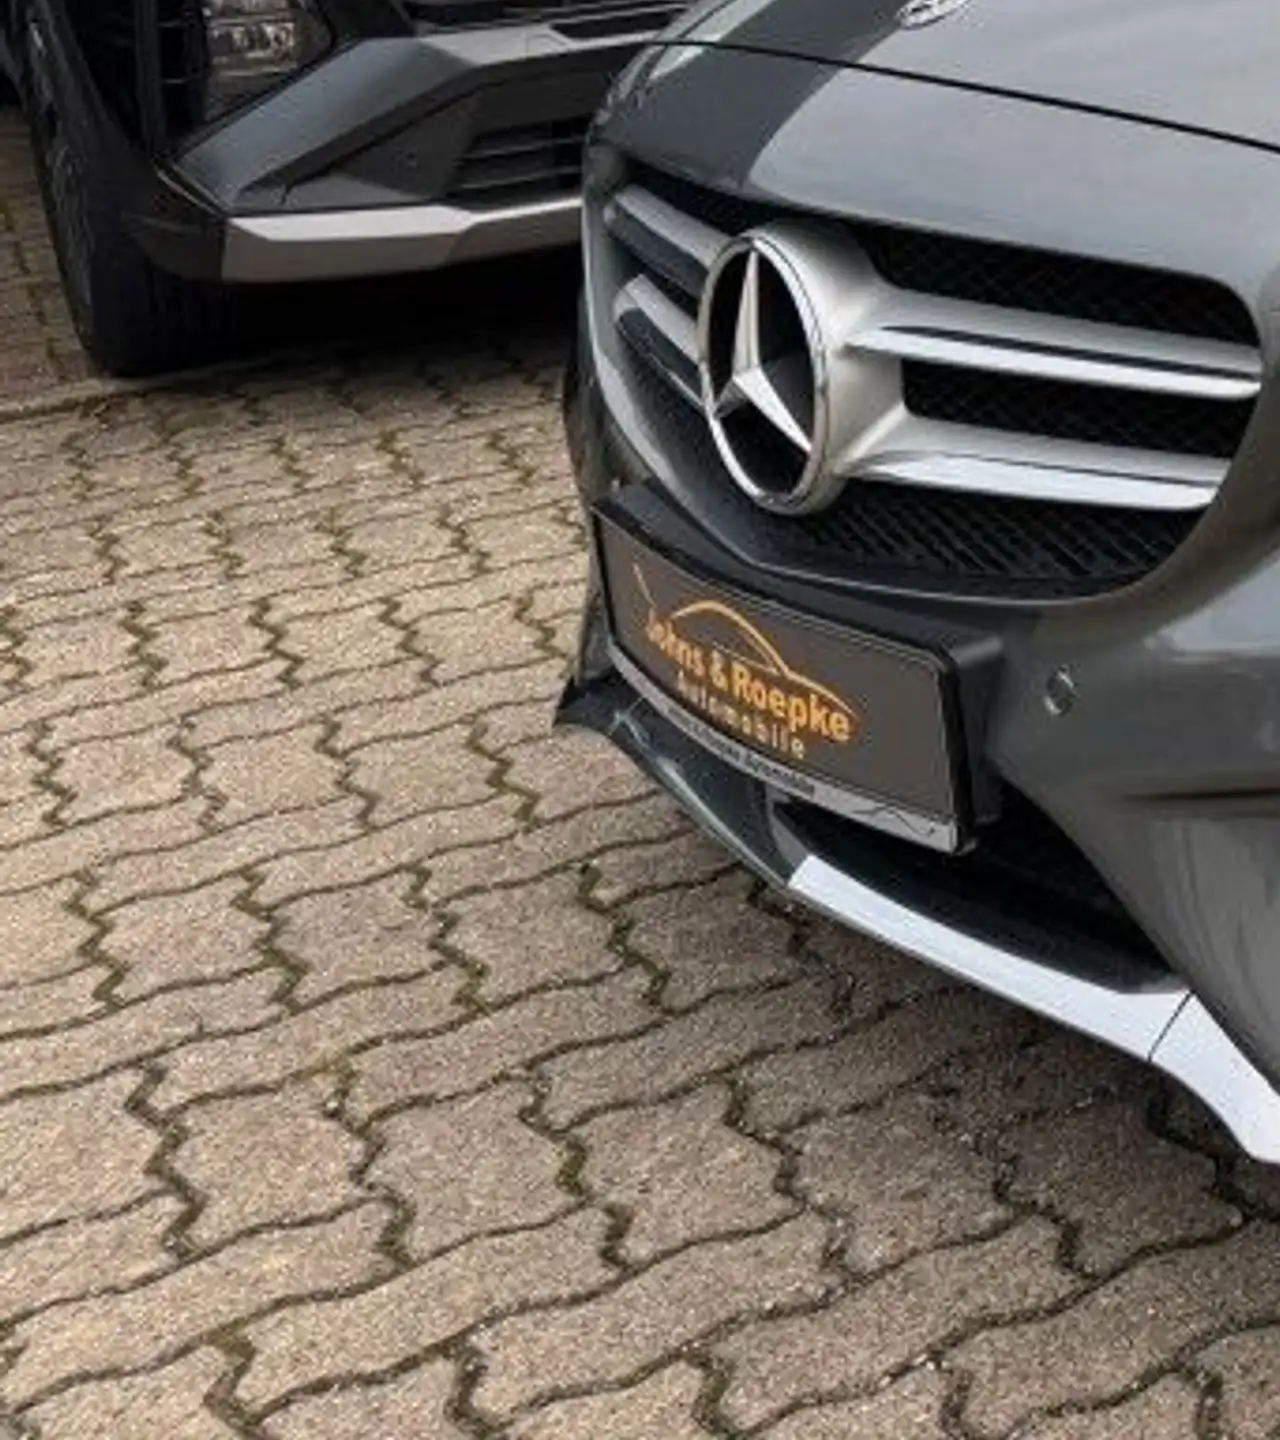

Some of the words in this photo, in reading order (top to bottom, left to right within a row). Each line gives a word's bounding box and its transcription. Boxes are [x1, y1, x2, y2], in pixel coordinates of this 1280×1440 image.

[645, 607, 706, 677] Johns
[709, 649, 729, 692] &
[731, 660, 851, 742] Roepke
